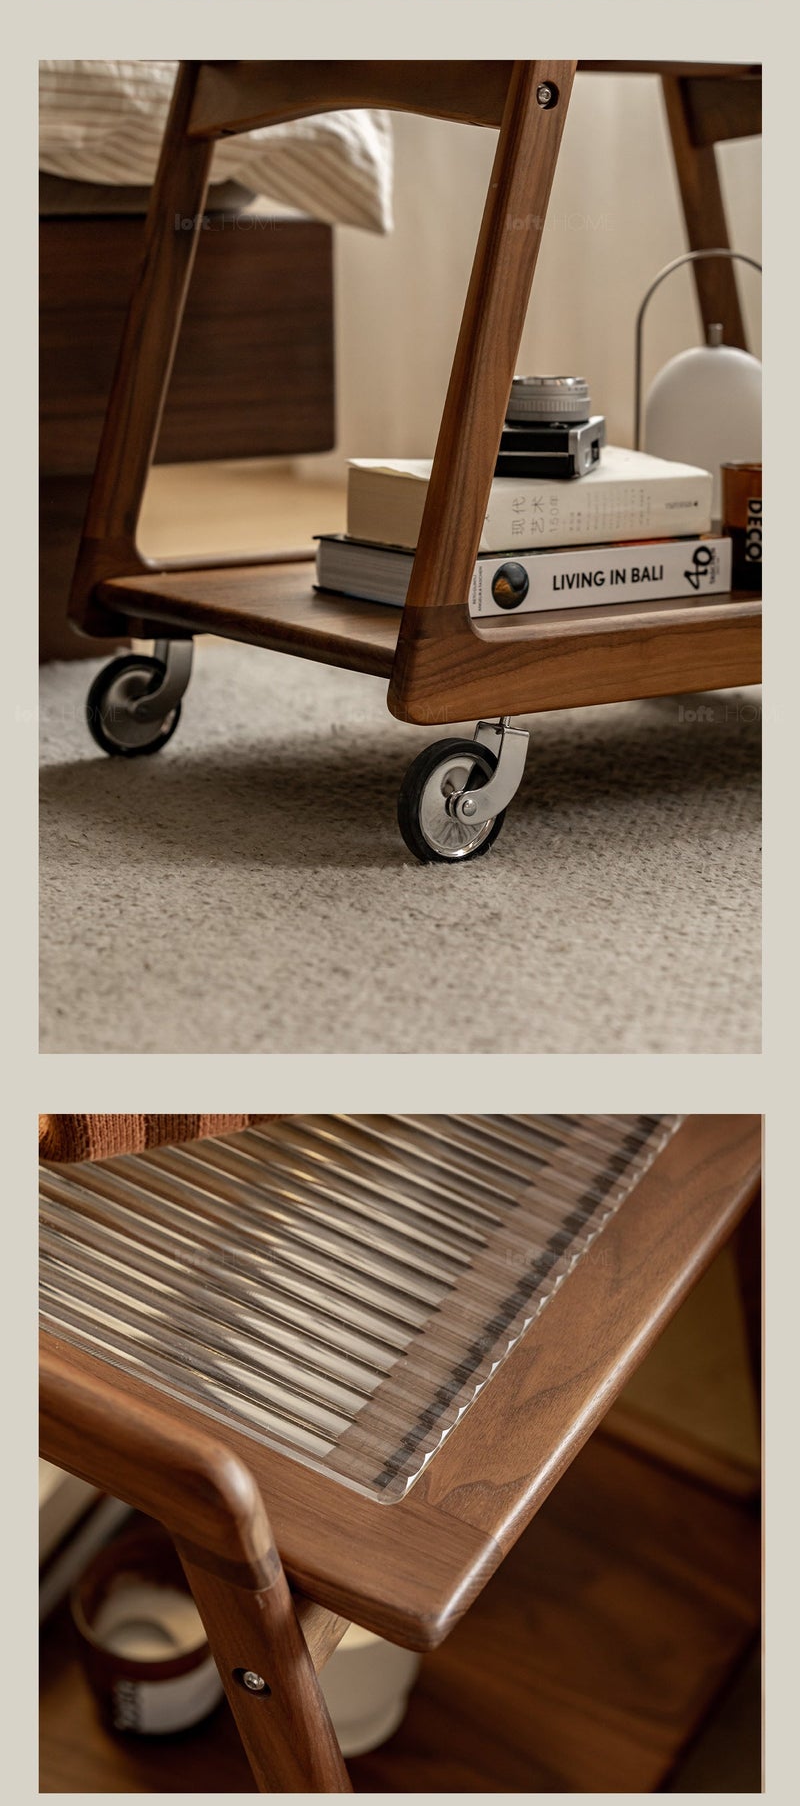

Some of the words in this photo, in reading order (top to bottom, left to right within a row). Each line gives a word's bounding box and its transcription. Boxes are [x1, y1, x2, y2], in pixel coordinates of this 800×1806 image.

[553, 571, 605, 591] LIVING
[610, 569, 626, 585] IN
[632, 565, 663, 583] BALI
